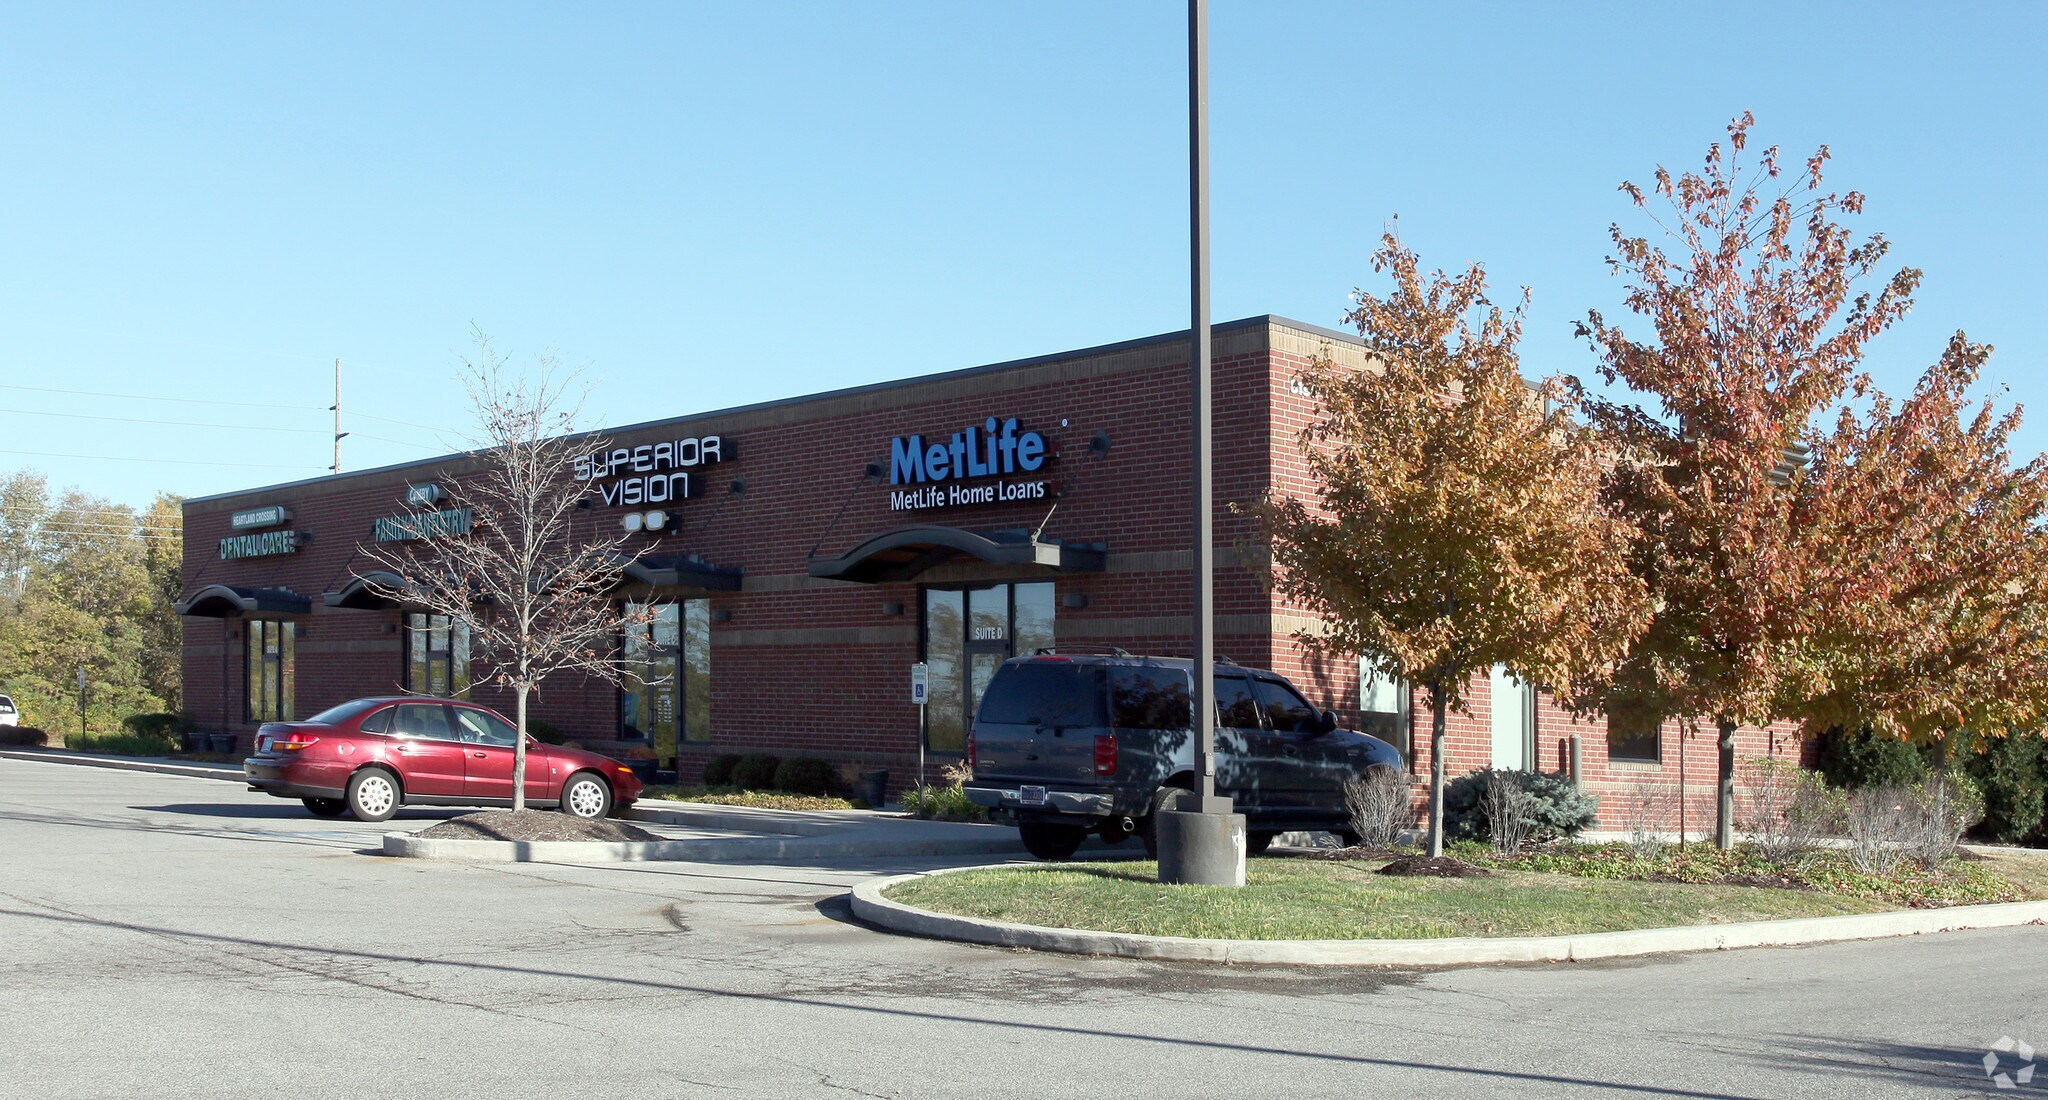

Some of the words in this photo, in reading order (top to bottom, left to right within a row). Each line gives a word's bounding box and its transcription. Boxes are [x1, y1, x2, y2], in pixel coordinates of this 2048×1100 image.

[574, 436, 721, 480] SUPERIOR
[890, 416, 1044, 485] MetLife
[600, 472, 688, 506] VISION
[891, 486, 945, 511] MetLife
[950, 485, 994, 505] Home
[999, 481, 1044, 501] Loans
[221, 534, 259, 560] DENTAL
[261, 530, 290, 556] CARE
[975, 627, 996, 640] SUITE
[997, 627, 1003, 639] D
